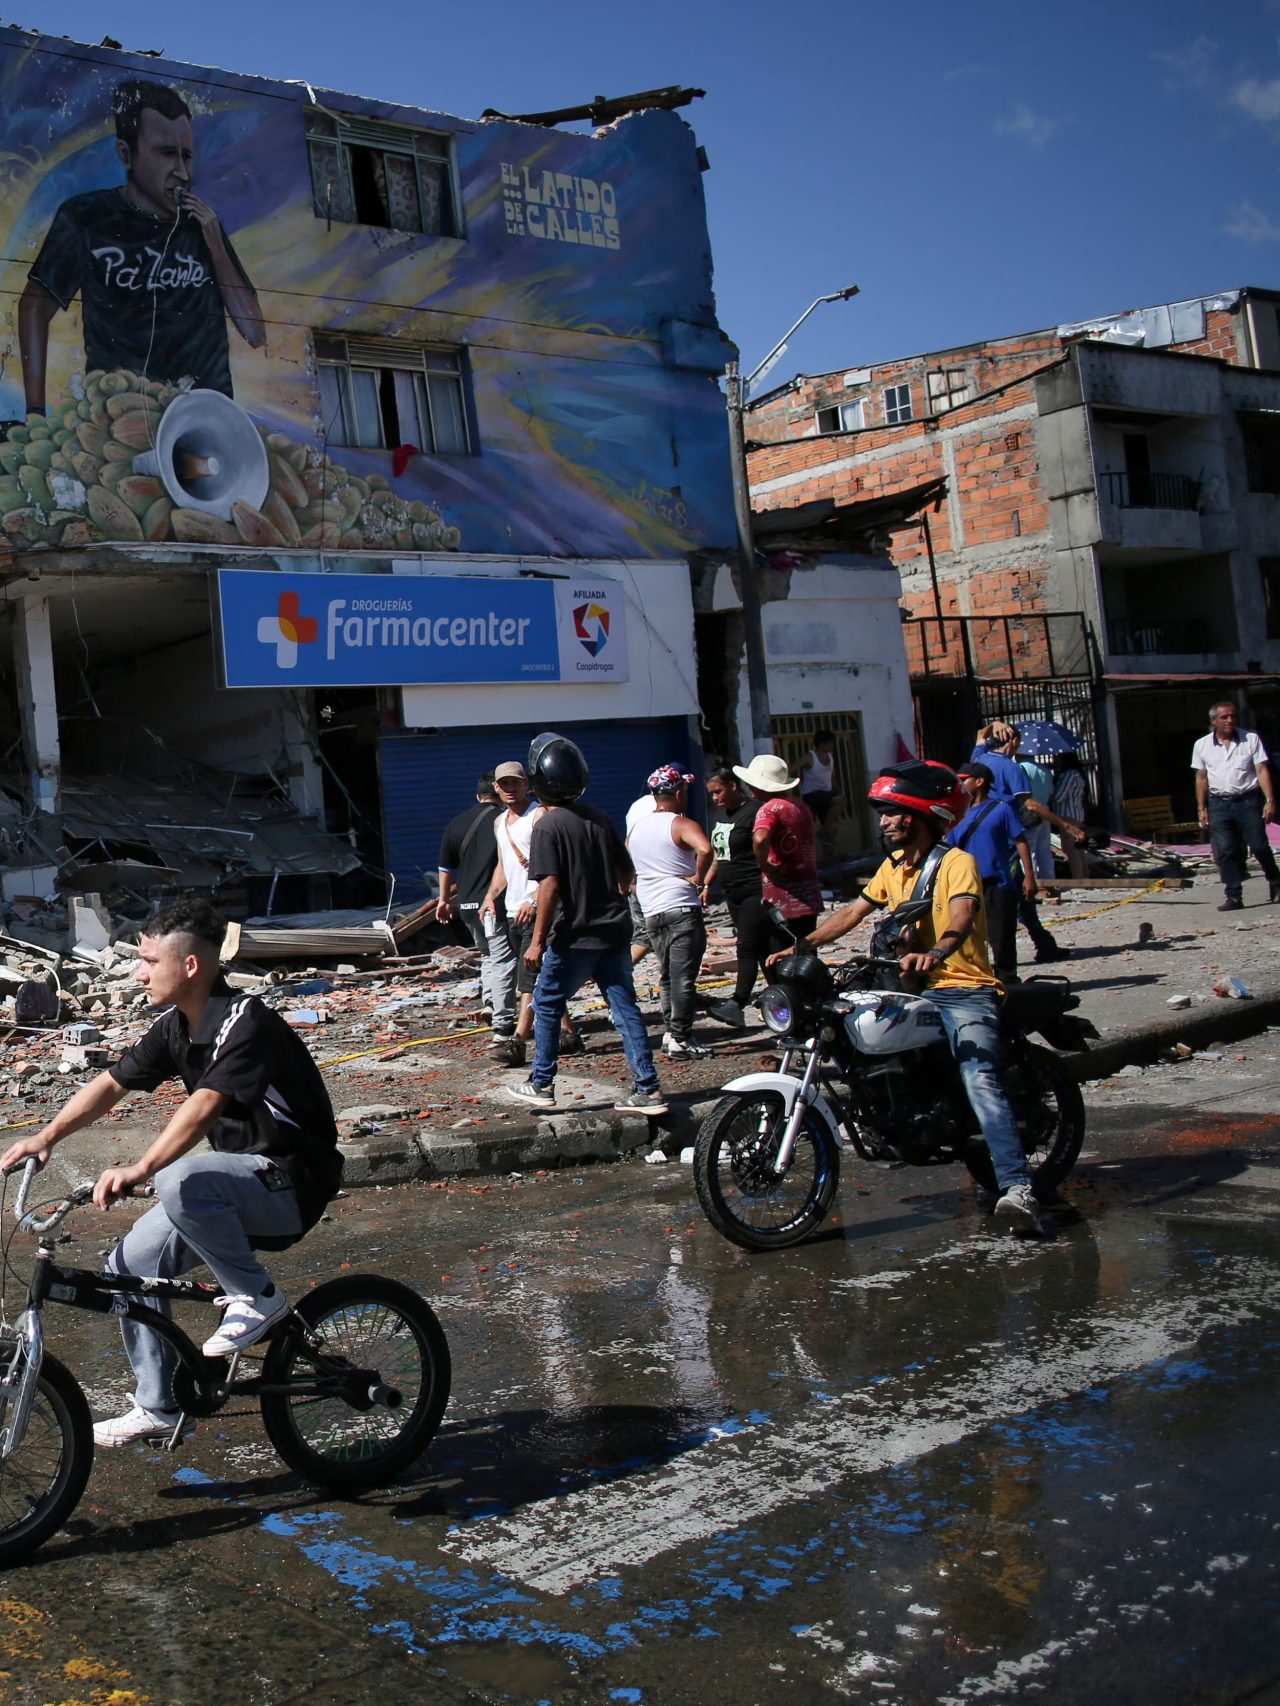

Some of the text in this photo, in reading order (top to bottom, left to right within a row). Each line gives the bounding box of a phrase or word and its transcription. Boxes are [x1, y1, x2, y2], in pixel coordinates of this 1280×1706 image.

[500, 162, 617, 218] EL LATIDO
[504, 200, 524, 222] DE
[506, 204, 621, 251] LAS CALLES
[352, 598, 413, 612] DROGUERÍAS
[573, 589, 607, 600] AFILIADA
[326, 599, 531, 660] farmacenter
[576, 662, 614, 673] Coopidrogas
